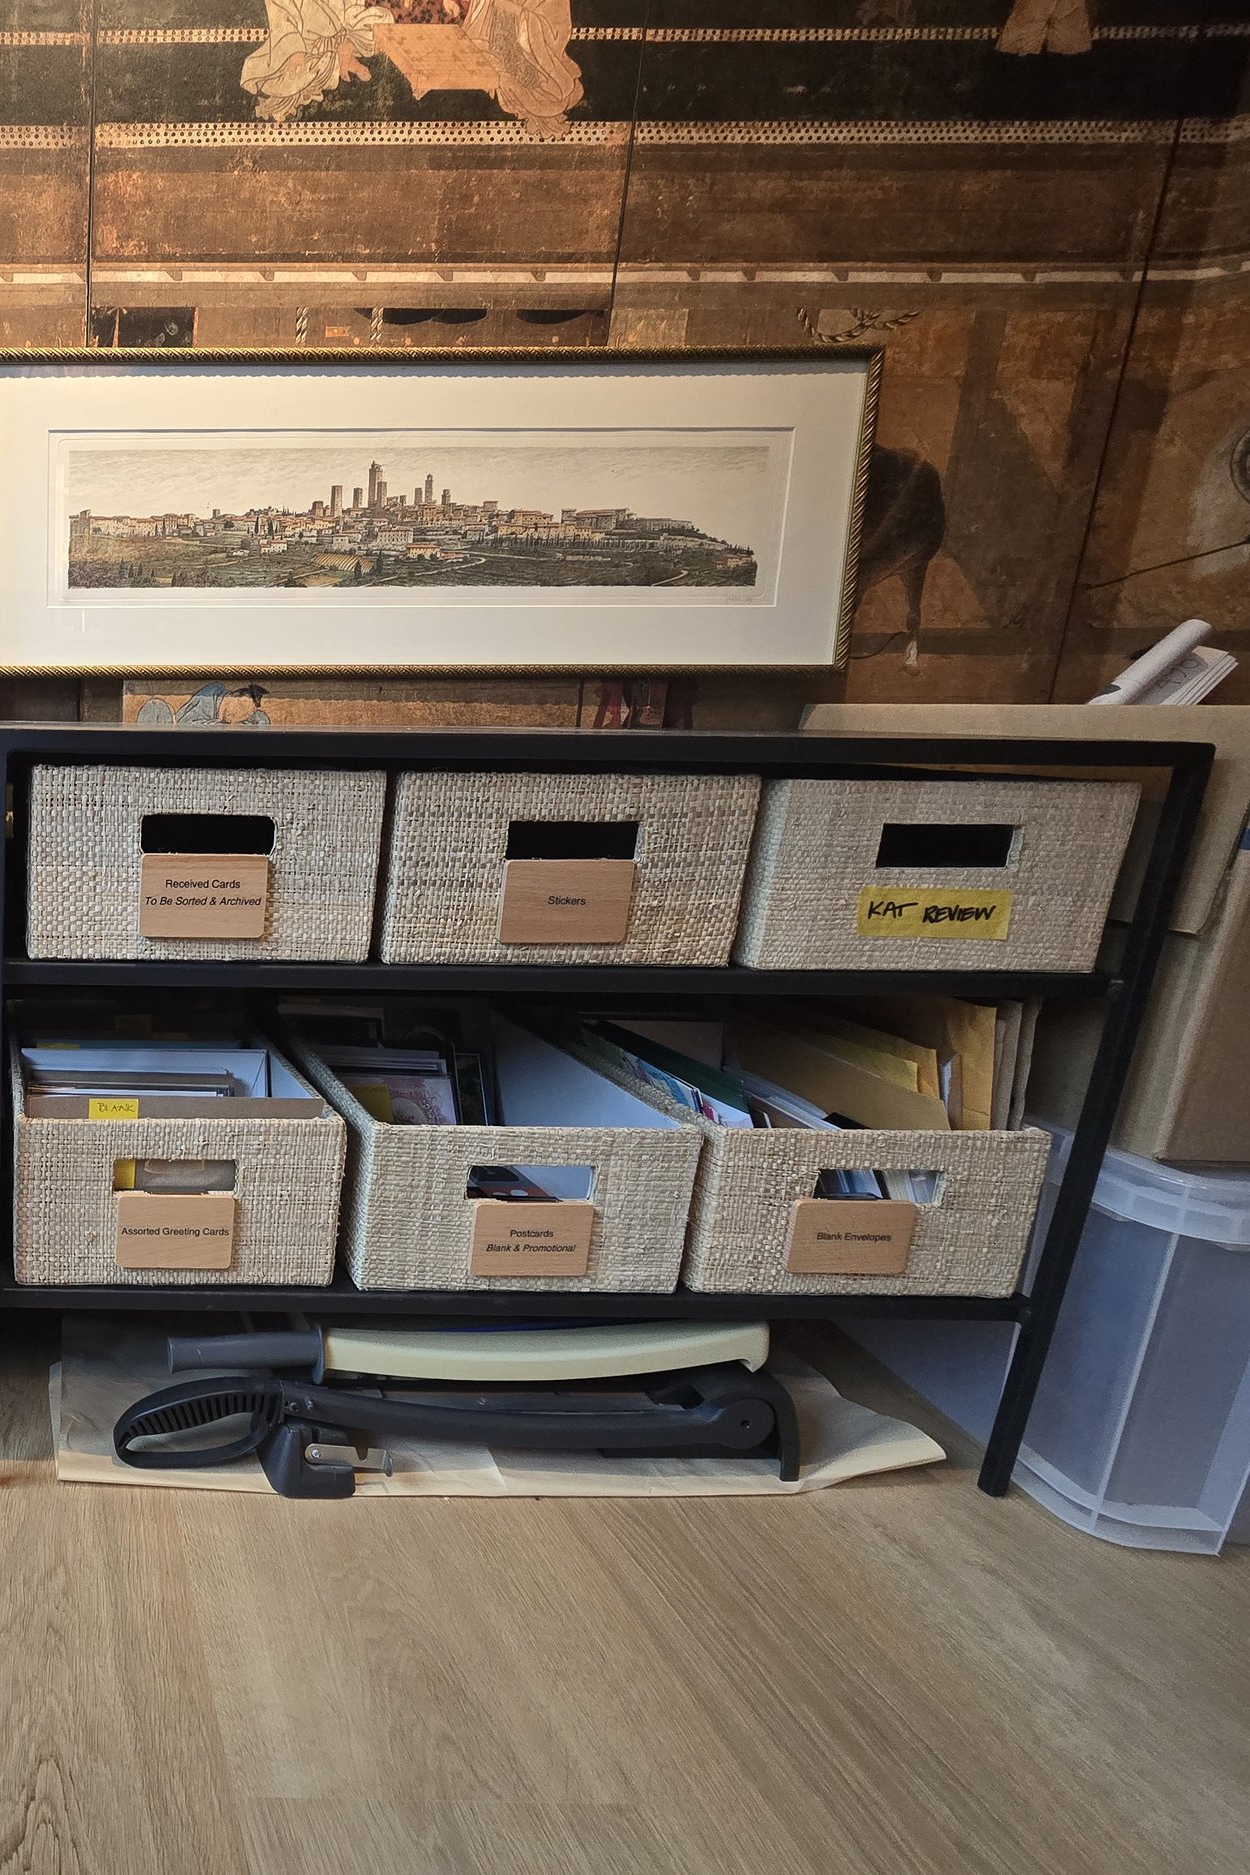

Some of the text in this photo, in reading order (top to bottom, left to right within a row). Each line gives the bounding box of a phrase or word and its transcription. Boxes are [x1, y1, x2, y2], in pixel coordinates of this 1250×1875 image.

[166, 880, 240, 888] Received Cards
[146, 897, 262, 906] To Be Sorted & Archived
[548, 896, 586, 905] Stickers
[868, 901, 996, 923] KAT REVIEW
[97, 1102, 135, 1112] BLANK
[162, 1228, 200, 1237] Greeting
[845, 1233, 891, 1242] Envelopes
